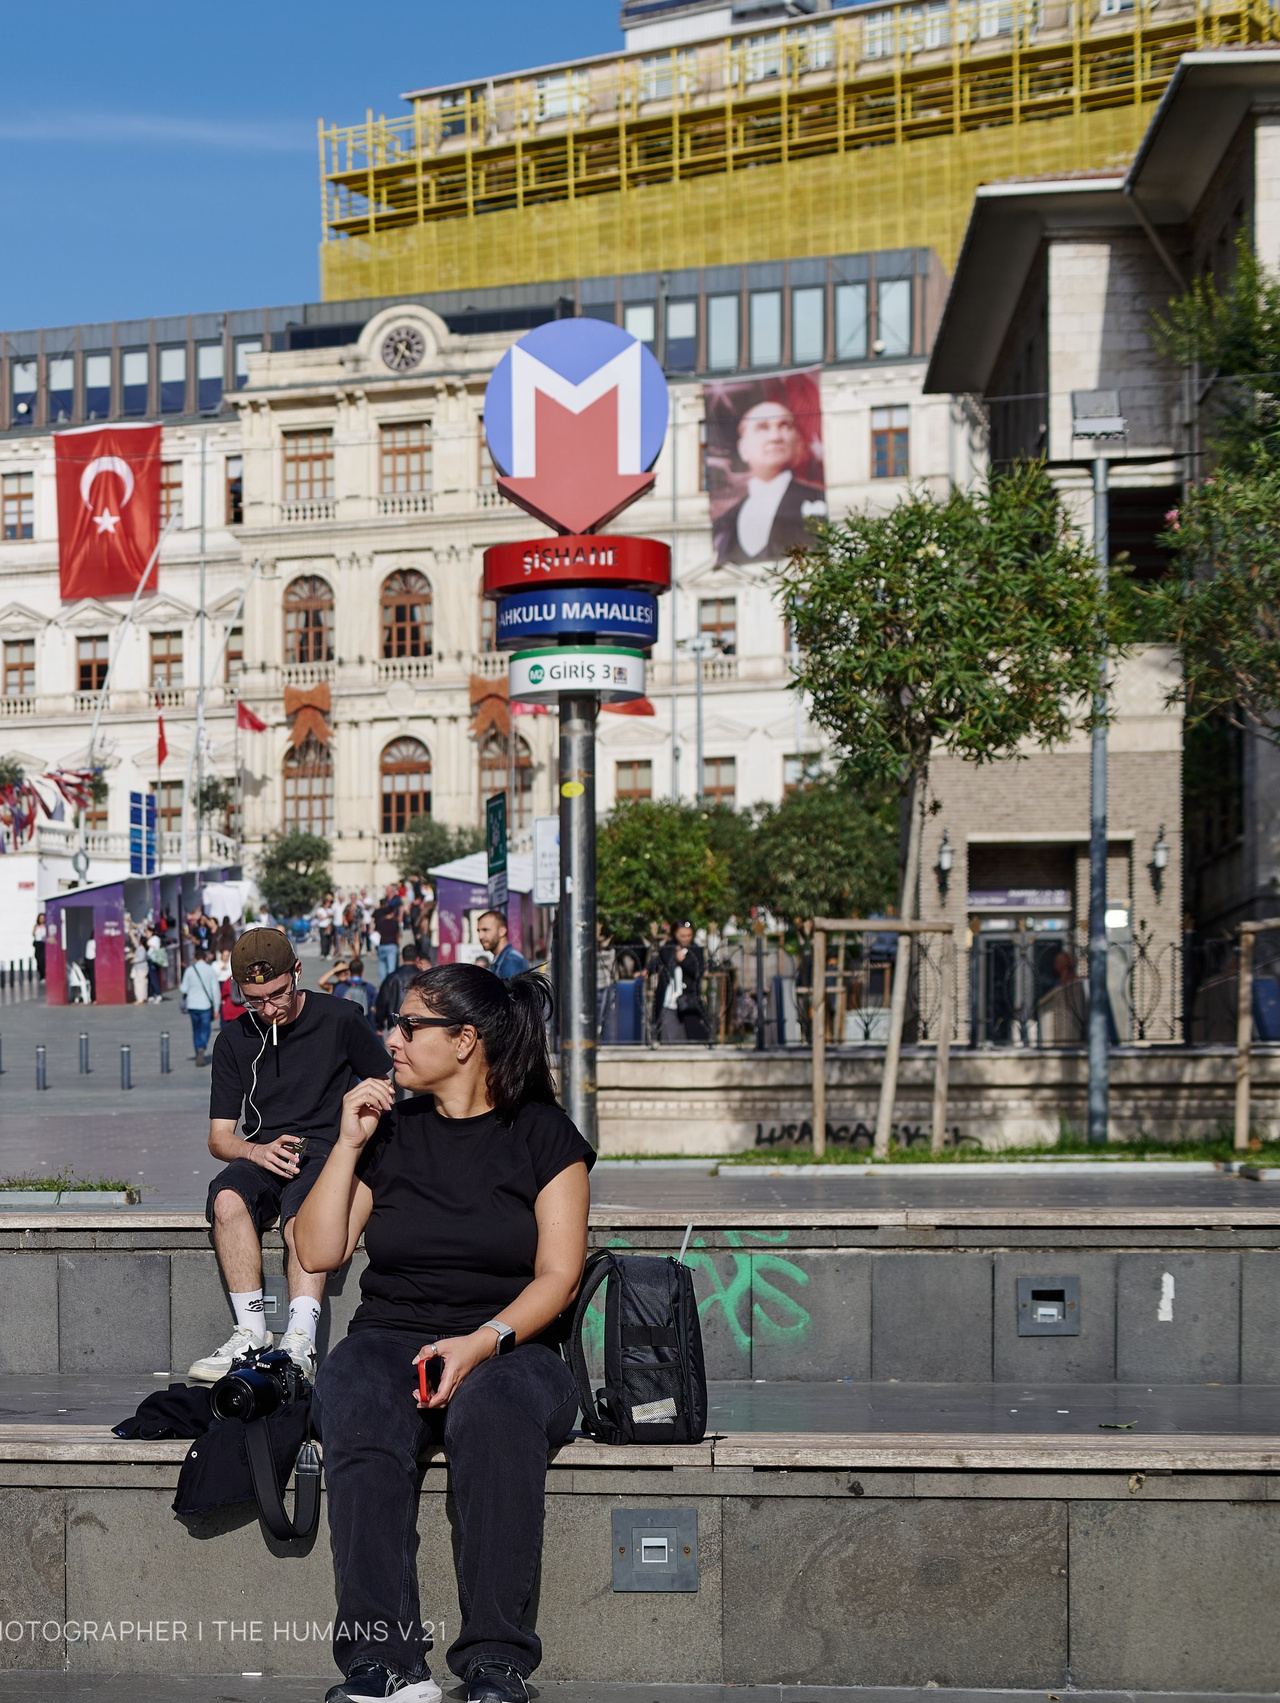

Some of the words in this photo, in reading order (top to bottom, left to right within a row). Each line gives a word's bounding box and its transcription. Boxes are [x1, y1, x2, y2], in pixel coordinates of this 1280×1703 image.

[523, 545, 619, 575] ŞİŞHANE
[499, 603, 556, 627] AHKULU
[562, 602, 653, 624] MAHALLESİ
[549, 661, 596, 682] GİRİŞ
[602, 665, 611, 679] 3
